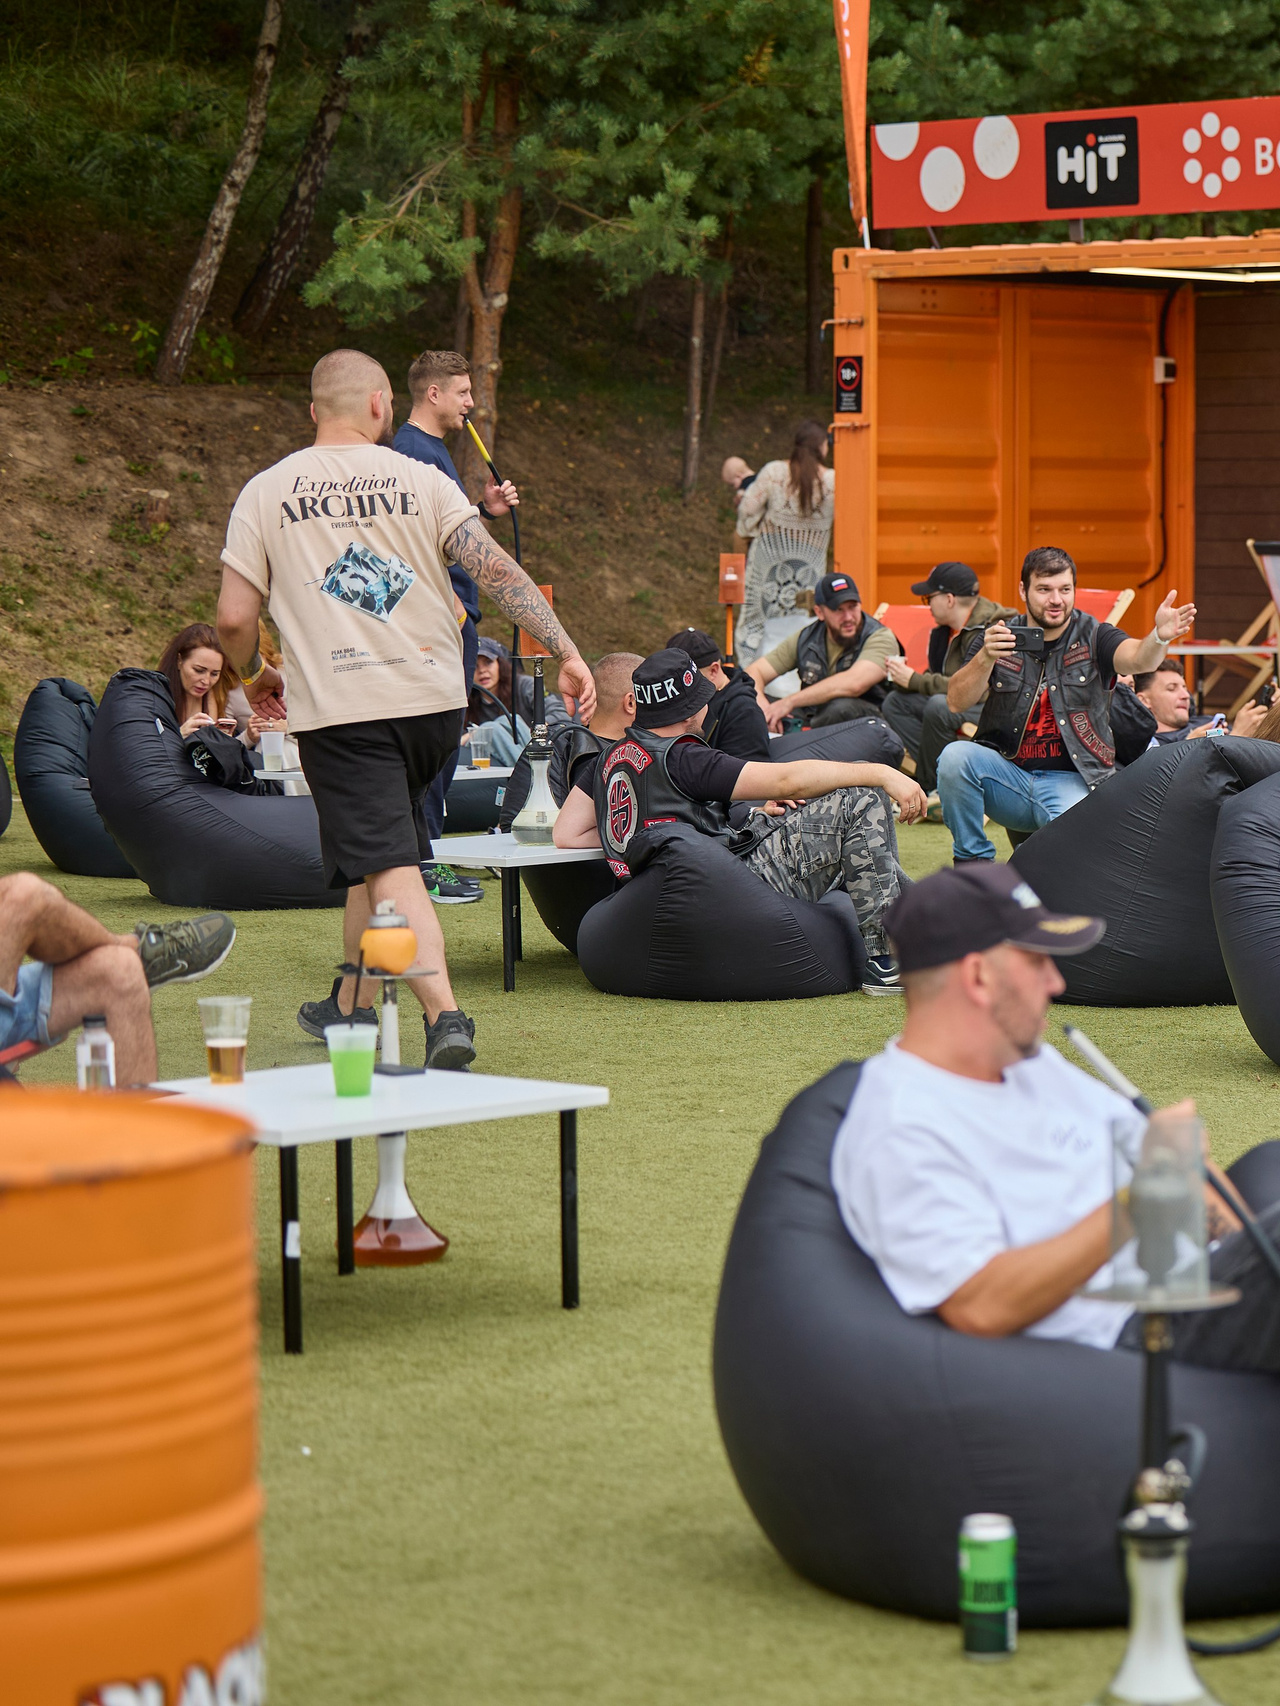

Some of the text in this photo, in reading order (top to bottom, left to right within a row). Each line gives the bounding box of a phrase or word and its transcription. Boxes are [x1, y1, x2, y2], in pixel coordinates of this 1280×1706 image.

[291, 474, 397, 497] Expedition
[280, 491, 419, 529] ARCHIVE
[331, 520, 354, 529] EVEREST
